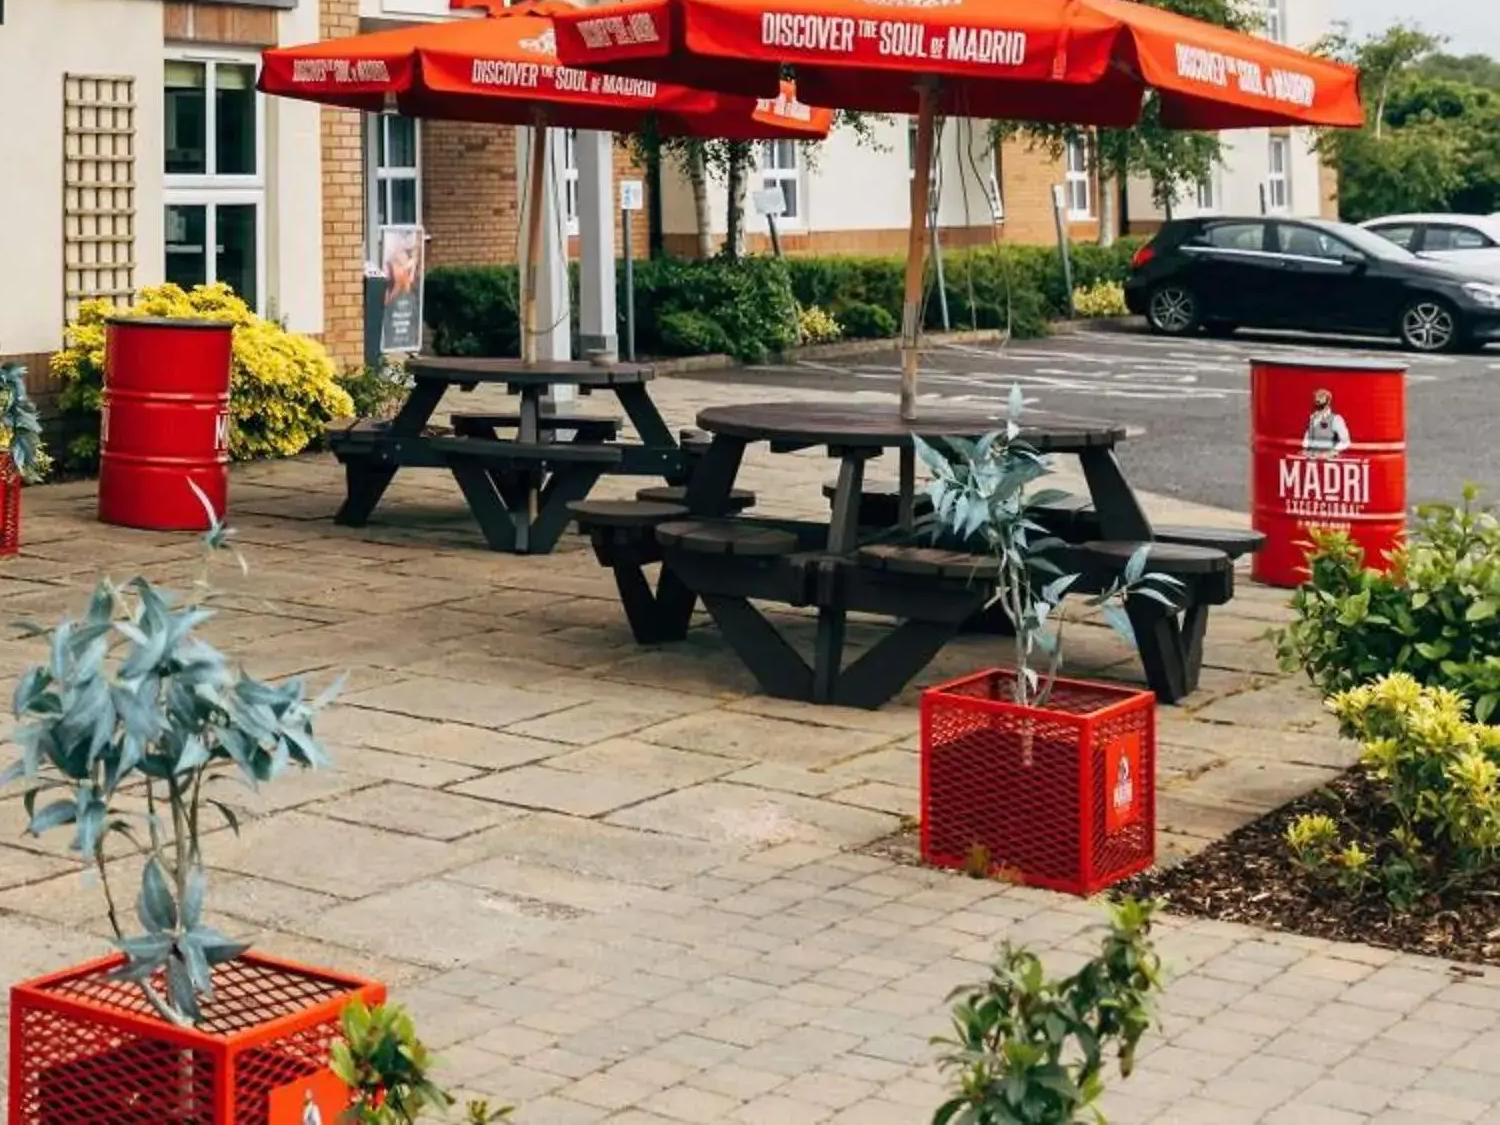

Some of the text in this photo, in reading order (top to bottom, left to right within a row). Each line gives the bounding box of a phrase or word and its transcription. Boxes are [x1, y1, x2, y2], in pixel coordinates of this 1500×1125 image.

[761, 11, 855, 53] DISCOVER
[858, 18, 878, 39] THE
[879, 21, 928, 59] SOUL
[947, 26, 1027, 66] MADRID
[471, 58, 538, 88] DISCOVER
[555, 66, 589, 92] SOUL
